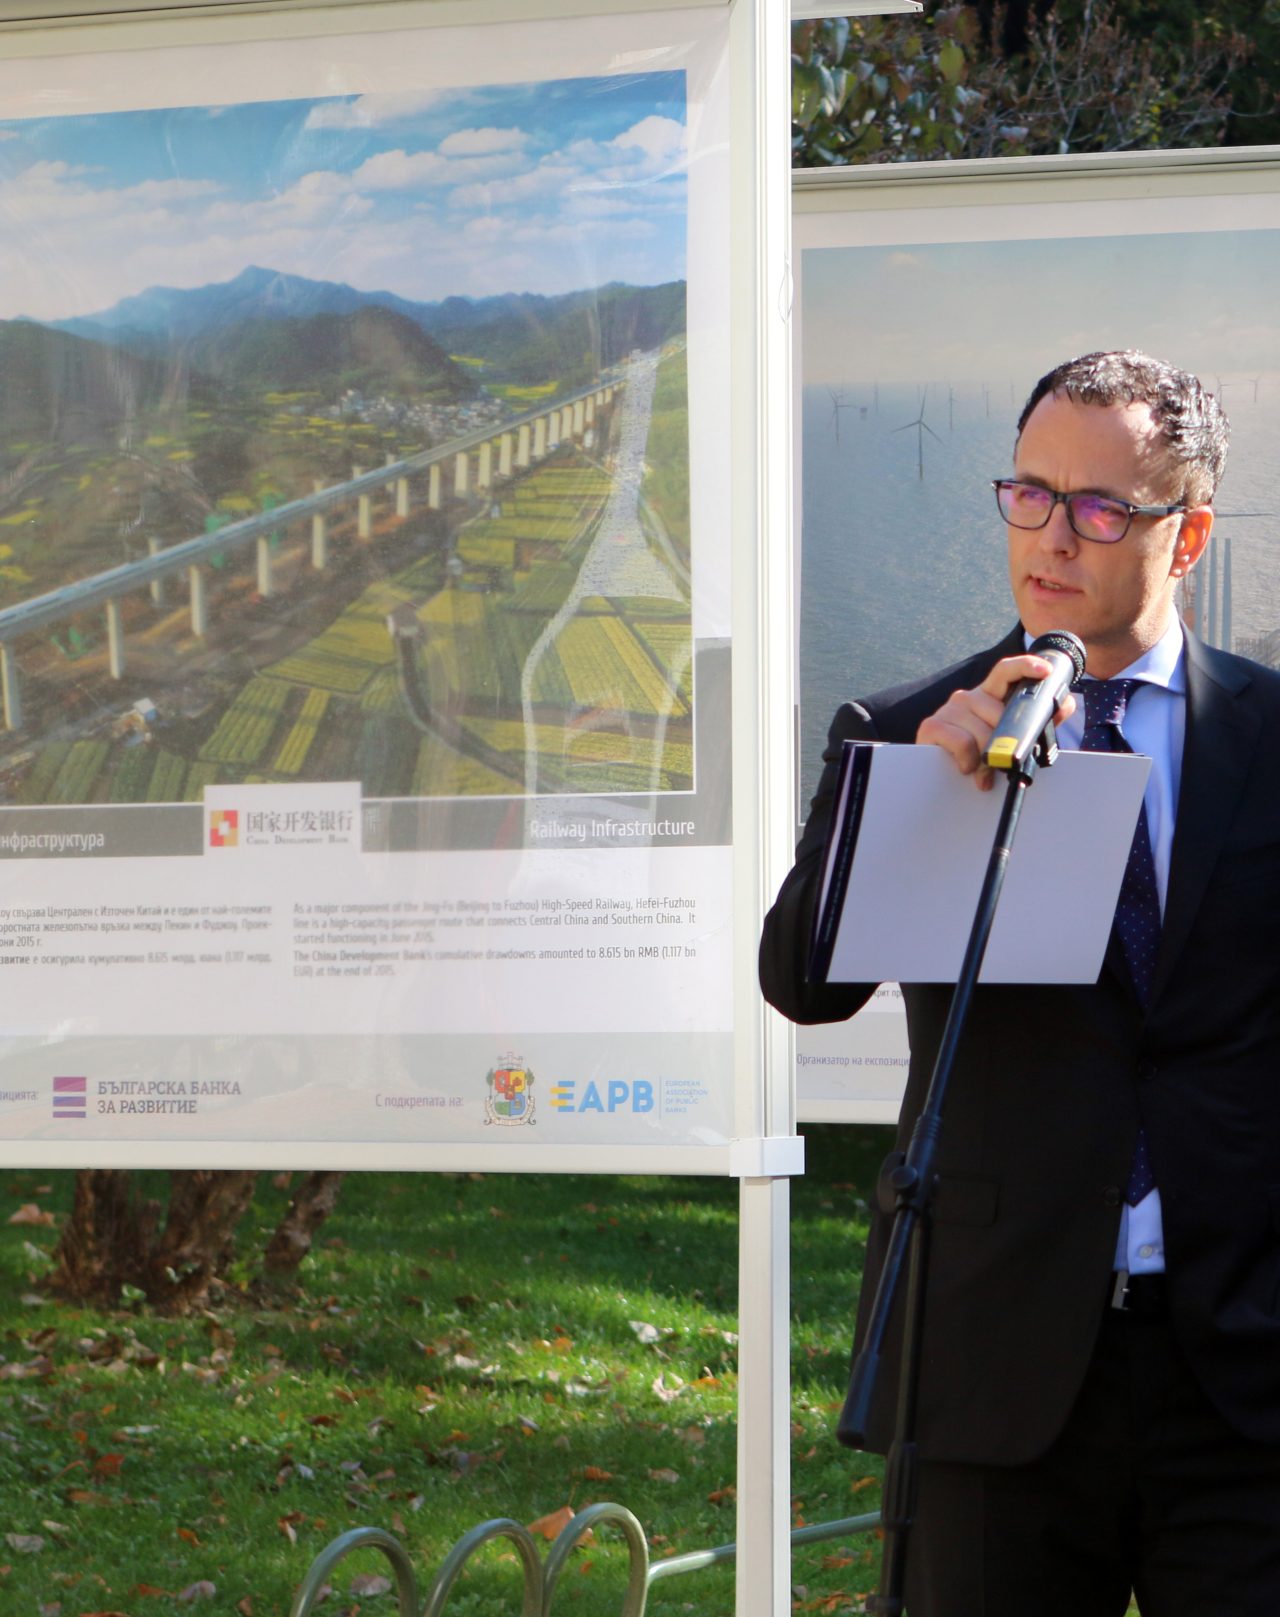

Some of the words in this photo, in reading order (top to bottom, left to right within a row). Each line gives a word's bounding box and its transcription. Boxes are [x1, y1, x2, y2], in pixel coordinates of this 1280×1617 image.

[247, 810, 353, 832] 国家开发银行
[530, 820, 586, 841] Railway
[591, 819, 695, 837] Infrastructure
[542, 899, 592, 913] High-Speed
[596, 898, 633, 912] Railway,
[636, 897, 696, 909] Hefei-Fuzhou
[47, 906, 92, 920] Централен
[101, 906, 134, 916] Източен
[136, 905, 161, 916] Китай
[530, 915, 560, 925] Central
[564, 914, 588, 925] China
[592, 914, 608, 925] and
[612, 914, 652, 925] Southern
[656, 913, 683, 924] China.
[689, 913, 696, 924] It
[16, 936, 34, 946] 2015
[539, 948, 583, 959] amounted
[587, 948, 596, 958] to
[599, 947, 620, 958] 8.615
[624, 947, 635, 958] bn
[638, 947, 658, 958] RMB
[685, 947, 696, 957] bn
[796, 1054, 849, 1067] Организатор
[852, 1058, 862, 1066] на
[98, 1081, 186, 1095] БЪЛГАРСКА
[192, 1081, 241, 1095] БАНКА
[385, 1096, 446, 1110] подкрепата
[550, 1080, 655, 1113] EAPB
[98, 1100, 116, 1114] ЗА
[120, 1100, 197, 1114] РАЗВИТИЕ
